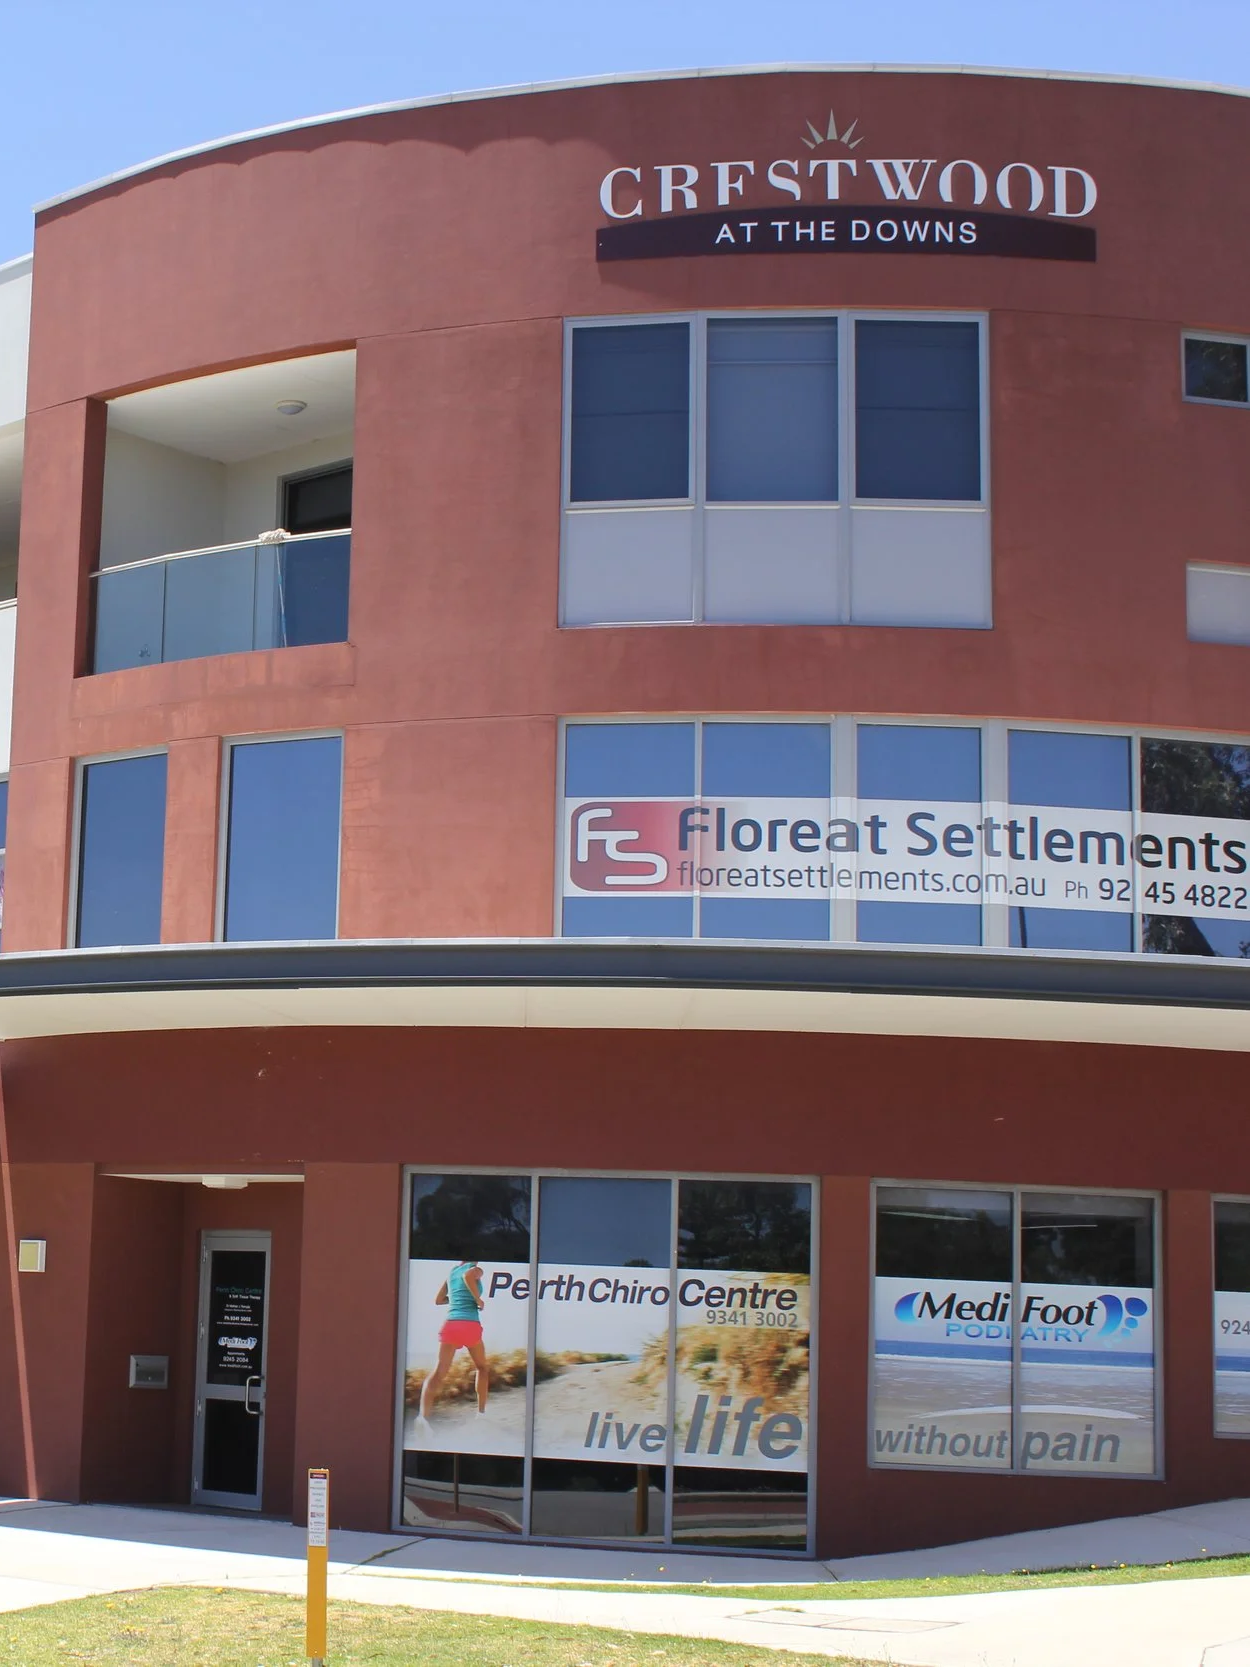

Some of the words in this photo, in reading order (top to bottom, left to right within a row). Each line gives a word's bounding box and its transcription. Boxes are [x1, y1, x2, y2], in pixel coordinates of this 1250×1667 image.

[715, 222, 758, 244] AT
[771, 220, 835, 242] THE
[851, 219, 977, 244] DOWNS
[678, 806, 887, 855] Floreat
[906, 811, 1247, 874] Settlements
[677, 861, 1046, 897] floreatsettlements.com.au
[1064, 880, 1089, 900] Ph
[1184, 884, 1248, 909] 4822
[678, 1279, 798, 1311] Centre
[917, 1291, 1012, 1323] Medi
[1020, 1295, 1098, 1327] Foot
[706, 1309, 748, 1326] 9341
[755, 1311, 799, 1329] 3002
[946, 1323, 1090, 1343] PODIATRY
[584, 1411, 668, 1453] live
[684, 1395, 803, 1460] life
[875, 1424, 1008, 1459] without
[1021, 1424, 1121, 1469] pain
